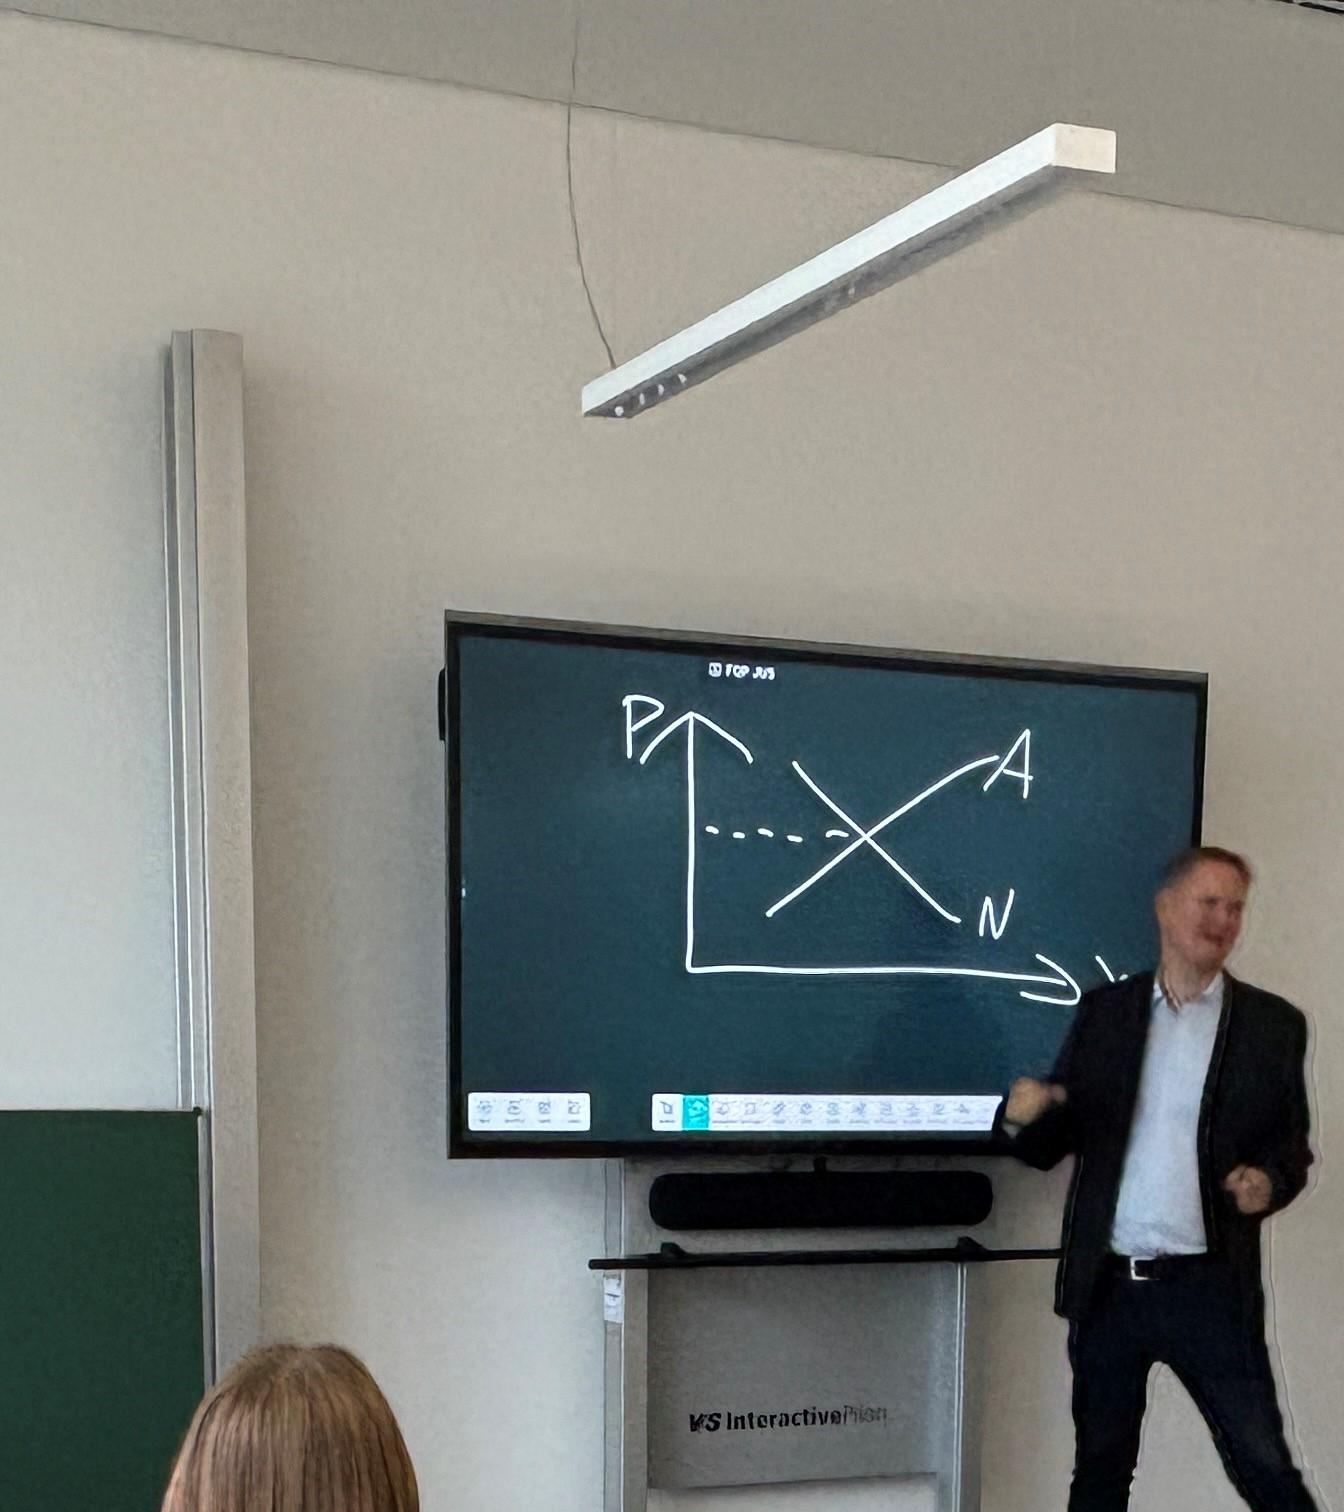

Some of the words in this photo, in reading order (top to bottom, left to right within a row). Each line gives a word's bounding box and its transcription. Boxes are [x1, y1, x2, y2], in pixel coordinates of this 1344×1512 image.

[622, 695, 665, 759] P
[983, 728, 1033, 799] A
[978, 888, 1015, 939] N
